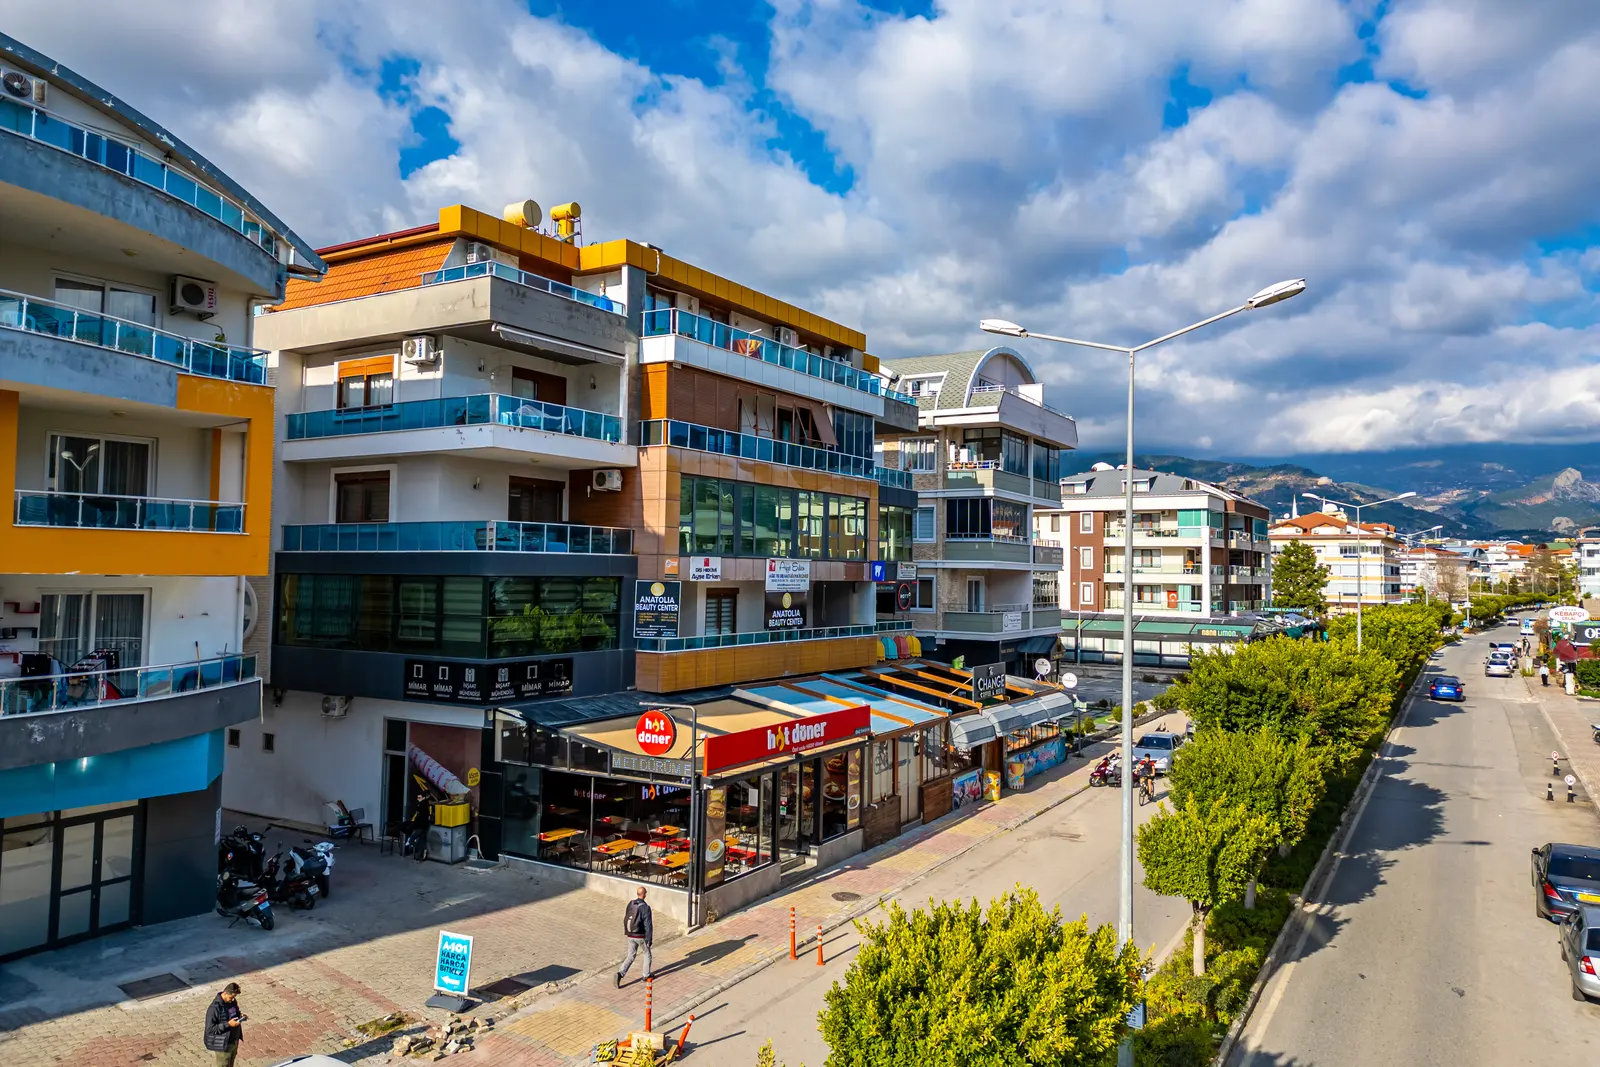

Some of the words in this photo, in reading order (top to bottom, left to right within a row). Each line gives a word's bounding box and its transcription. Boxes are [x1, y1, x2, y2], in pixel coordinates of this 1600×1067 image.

[640, 596, 675, 604] ANATOLIA
[657, 604, 679, 612] CENTER
[772, 609, 801, 618] ANATOLIA
[768, 619, 786, 627] BEAUTY
[786, 617, 804, 626] CENTER
[408, 681, 427, 691] MİMAR
[521, 682, 542, 692] MİMAR
[977, 673, 1005, 691] CHANGE
[433, 683, 453, 693] MİMAR
[791, 721, 828, 744] döner
[441, 950, 467, 961] HARCA
[440, 958, 465, 968] HARCA
